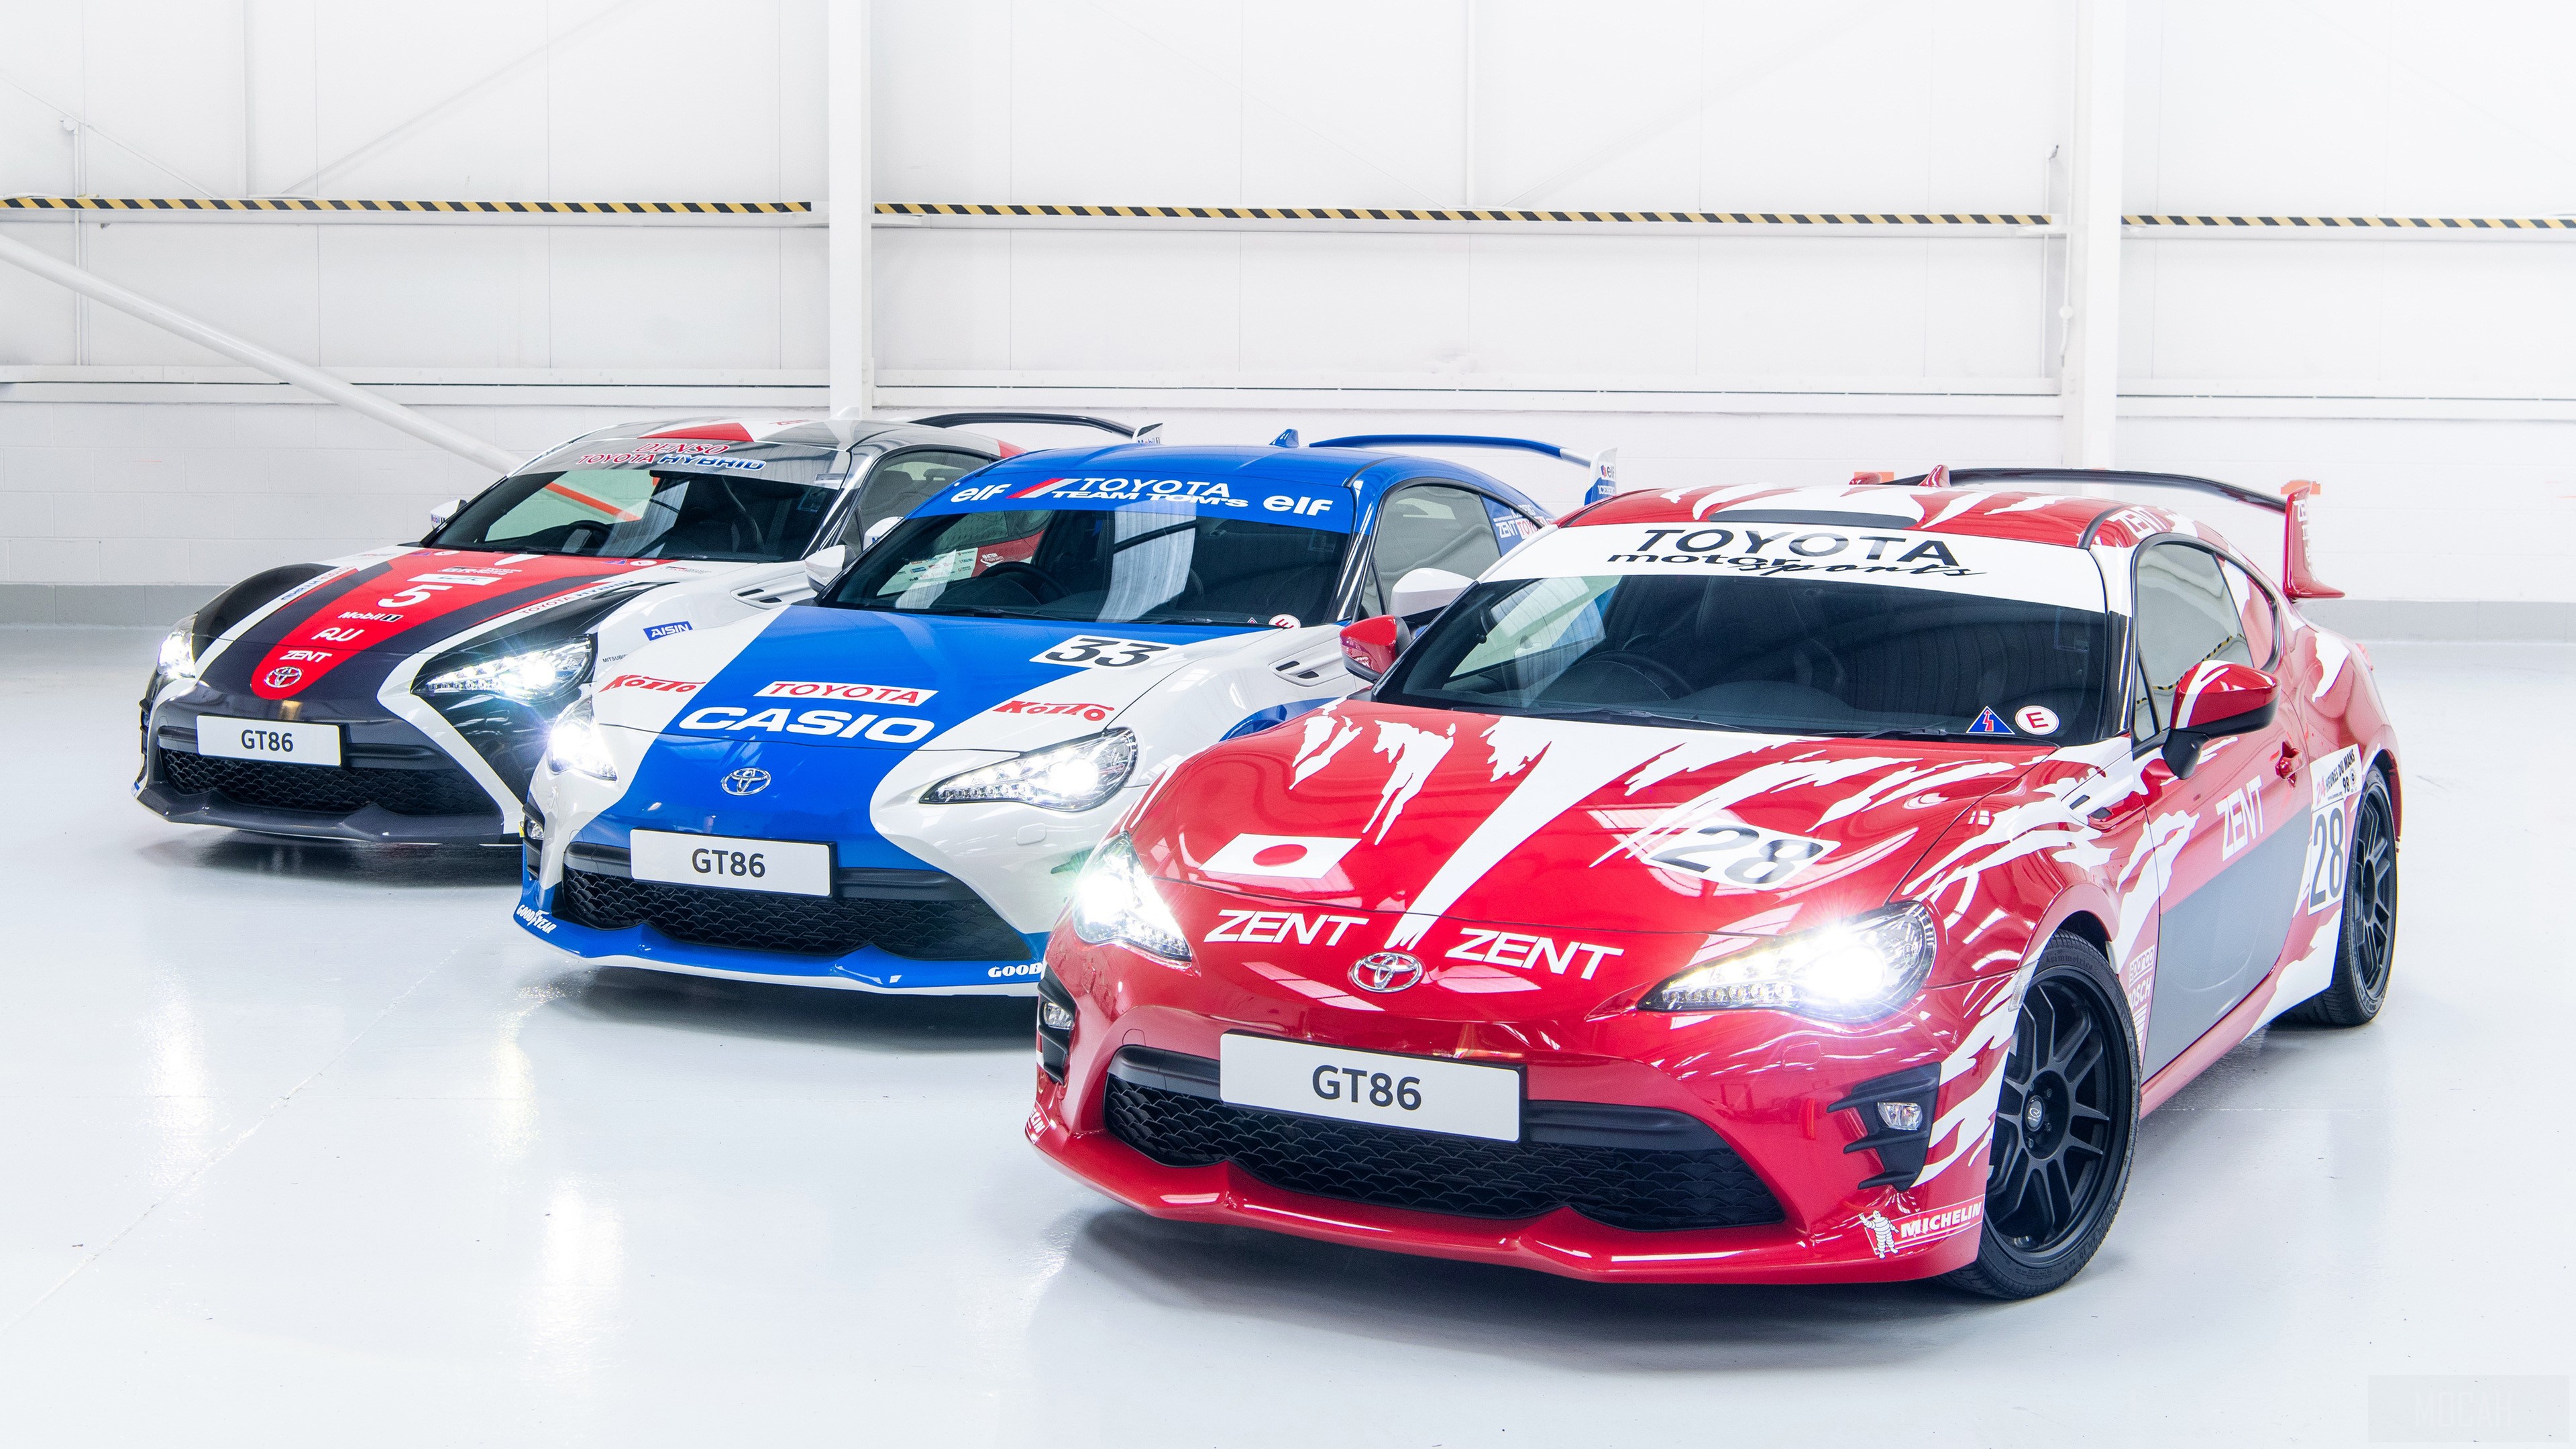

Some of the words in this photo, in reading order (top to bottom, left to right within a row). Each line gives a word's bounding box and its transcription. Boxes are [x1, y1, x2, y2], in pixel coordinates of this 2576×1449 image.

[634, 443, 730, 454] DENSO
[575, 453, 656, 464] TOYOTA
[657, 454, 767, 471] HYBRID
[951, 484, 1012, 502] elf
[1080, 477, 1230, 498] TOYOTA
[1051, 491, 1140, 500] TEAM
[1146, 494, 1249, 507] TOM'S
[1263, 495, 1333, 517] elf
[1495, 519, 1518, 538] ZENT
[2107, 506, 2167, 539] ZENT
[1635, 529, 1960, 566] TOYOTA
[378, 585, 453, 607] 5
[520, 596, 572, 614] TOYOTA
[337, 611, 385, 621] Mobil
[651, 623, 690, 638] AISIN
[279, 650, 332, 663] ZENT
[1046, 638, 1169, 667] 33
[767, 683, 919, 703] TOYOTA
[679, 707, 934, 743] CASIO
[2026, 712, 2049, 729] E
[241, 729, 294, 753] GT86
[2343, 776, 2350, 794] 98
[2216, 775, 2263, 861] ZENT
[691, 848, 765, 878] GT86
[1650, 824, 1824, 884] 28
[2310, 808, 2344, 908] 28
[517, 904, 557, 934] GOODYEAR
[1204, 910, 1368, 947] ZENT
[1446, 928, 1624, 980] ZENT
[2130, 948, 2153, 981] sparco
[988, 962, 1042, 977] GOOD
[1311, 1064, 1423, 1111] GT86
[1901, 1202, 1982, 1238] MICHELIN
